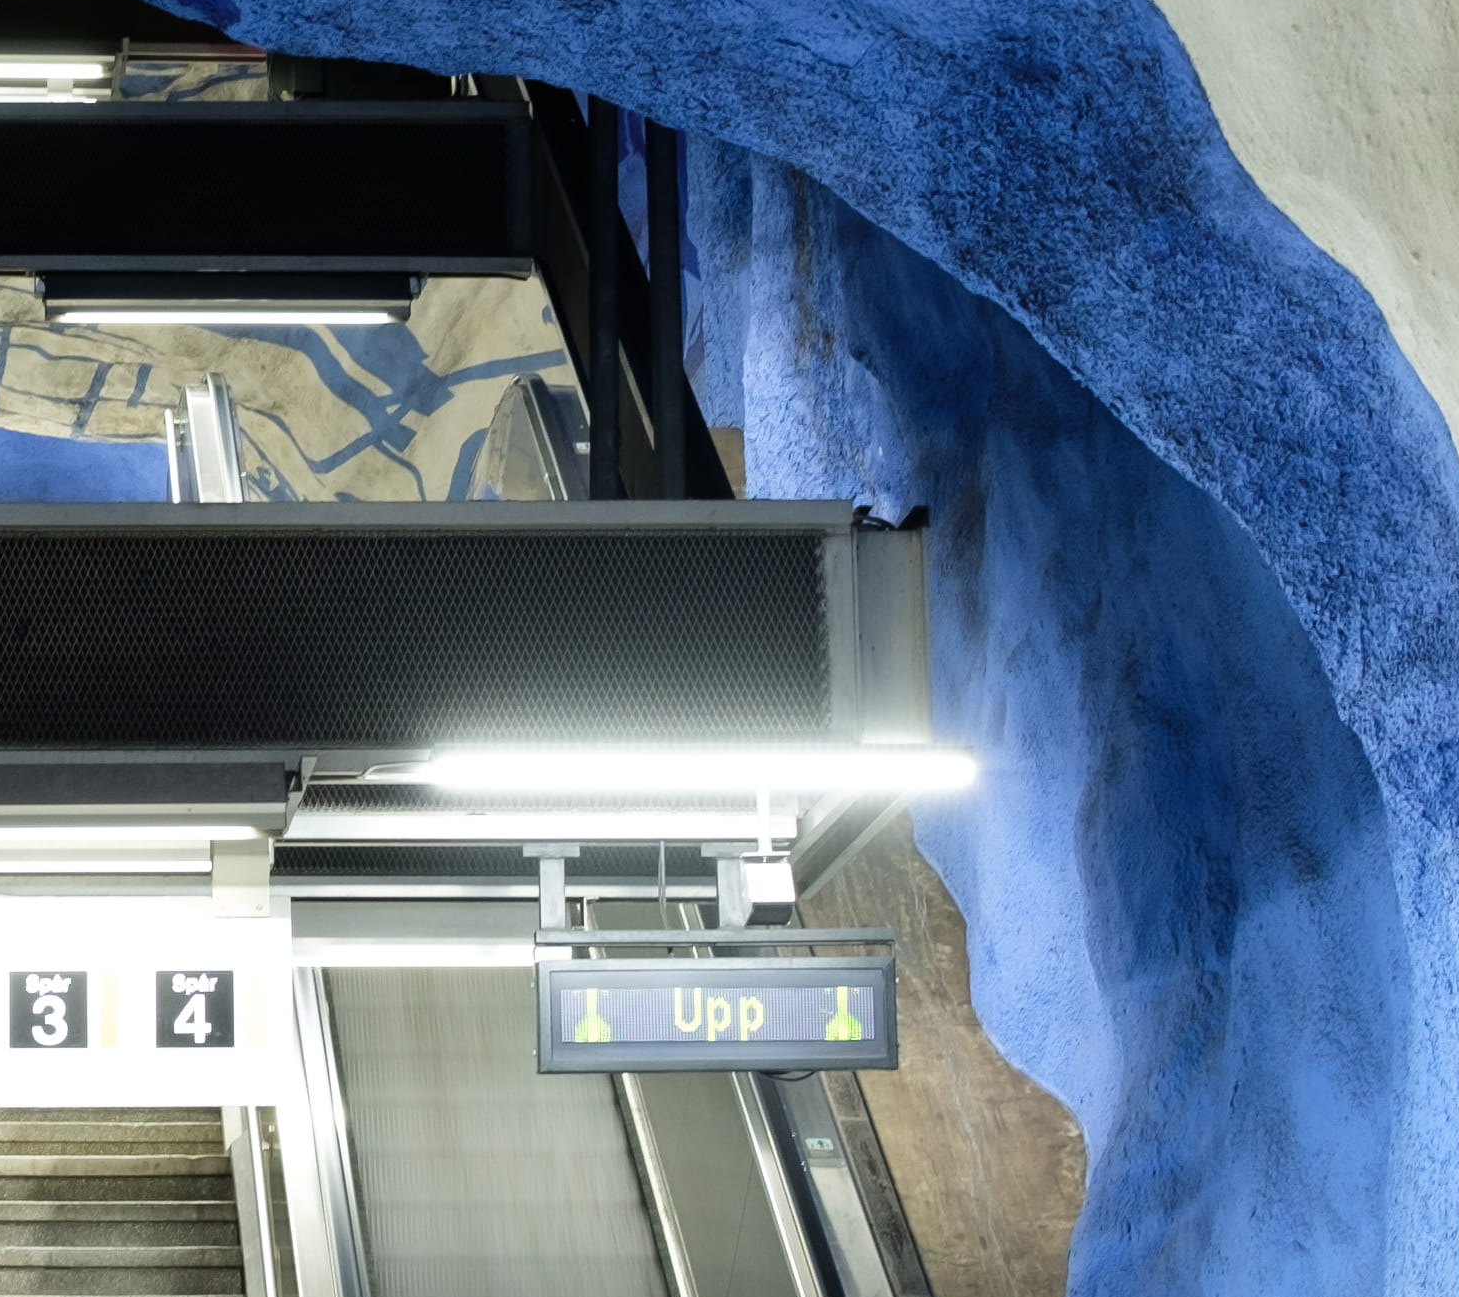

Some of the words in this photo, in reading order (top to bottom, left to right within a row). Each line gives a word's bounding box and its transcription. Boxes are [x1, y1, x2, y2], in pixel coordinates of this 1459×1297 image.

[25, 973, 72, 996] Spår
[172, 972, 218, 995] Spår
[31, 994, 69, 1046] 3
[173, 993, 212, 1044] 4
[674, 986, 764, 1042] Upp
